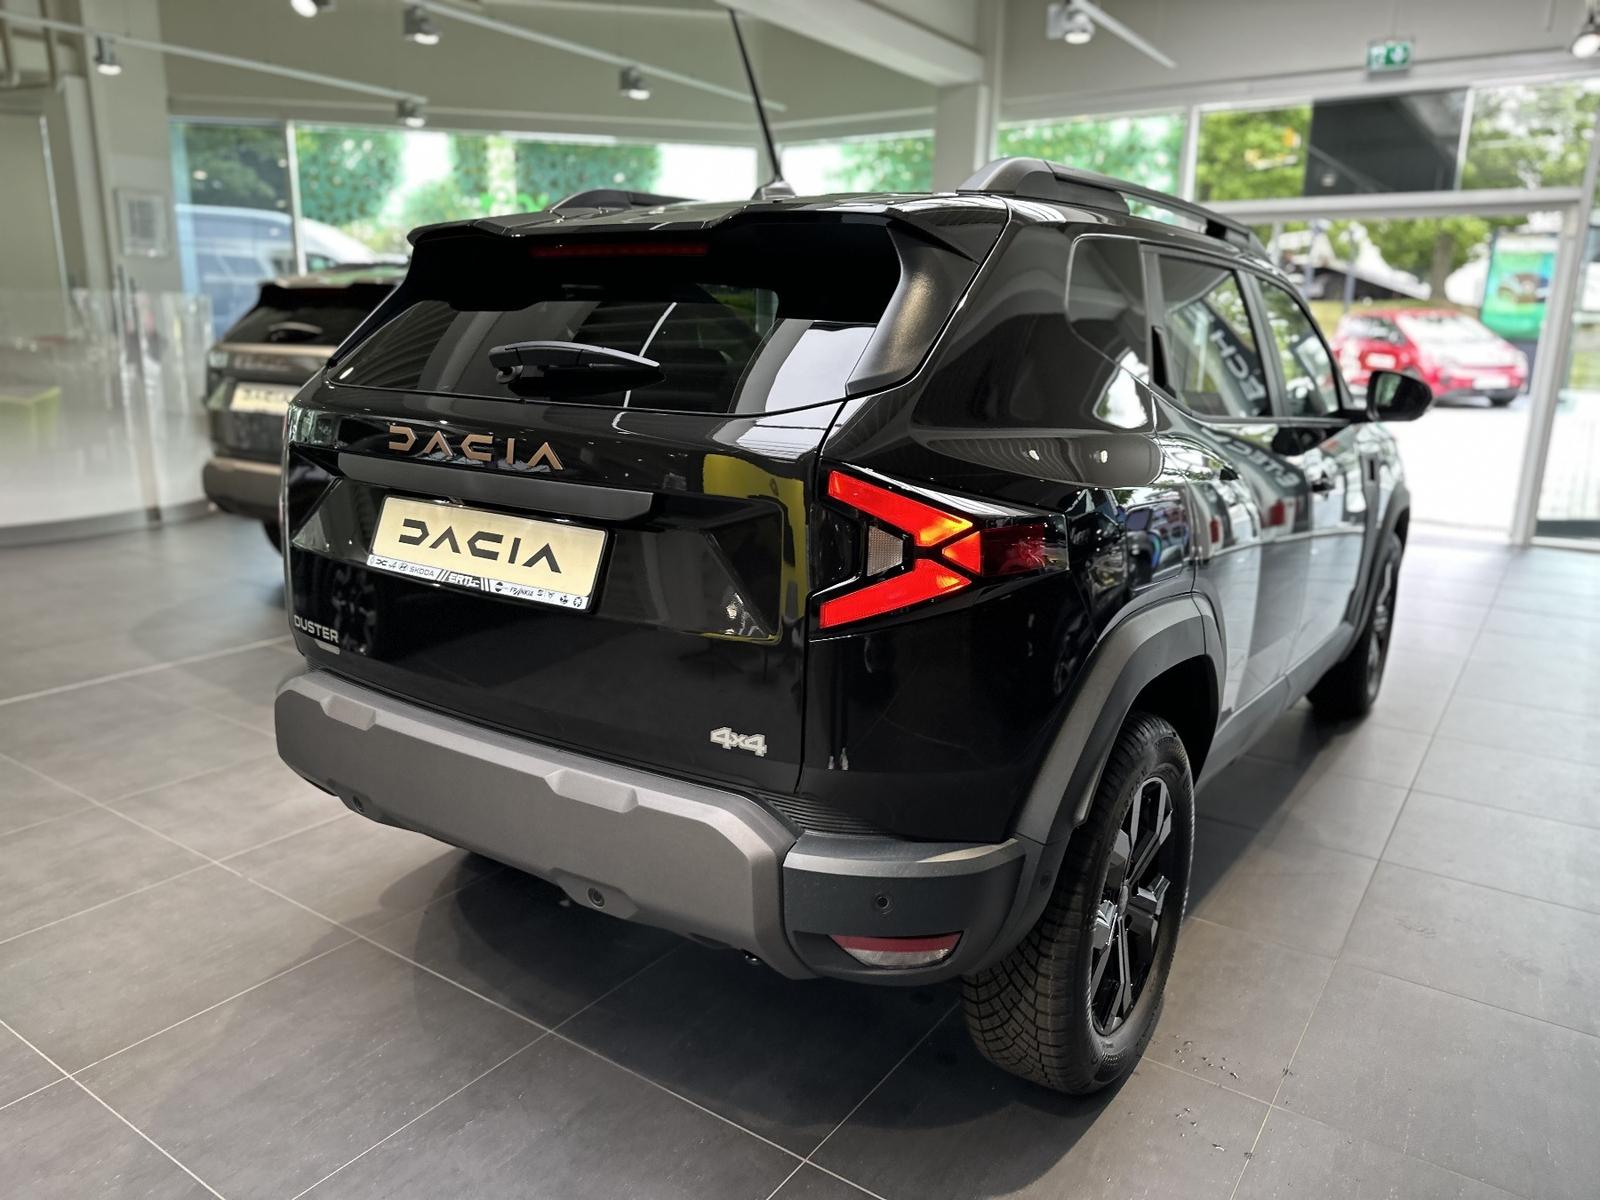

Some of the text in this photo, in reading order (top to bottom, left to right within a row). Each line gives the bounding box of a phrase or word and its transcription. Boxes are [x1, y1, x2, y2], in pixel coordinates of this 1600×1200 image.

[388, 424, 564, 471] DACIA
[398, 518, 562, 574] DACIA
[293, 614, 339, 644] DUSTER
[710, 726, 768, 757] 4x4
